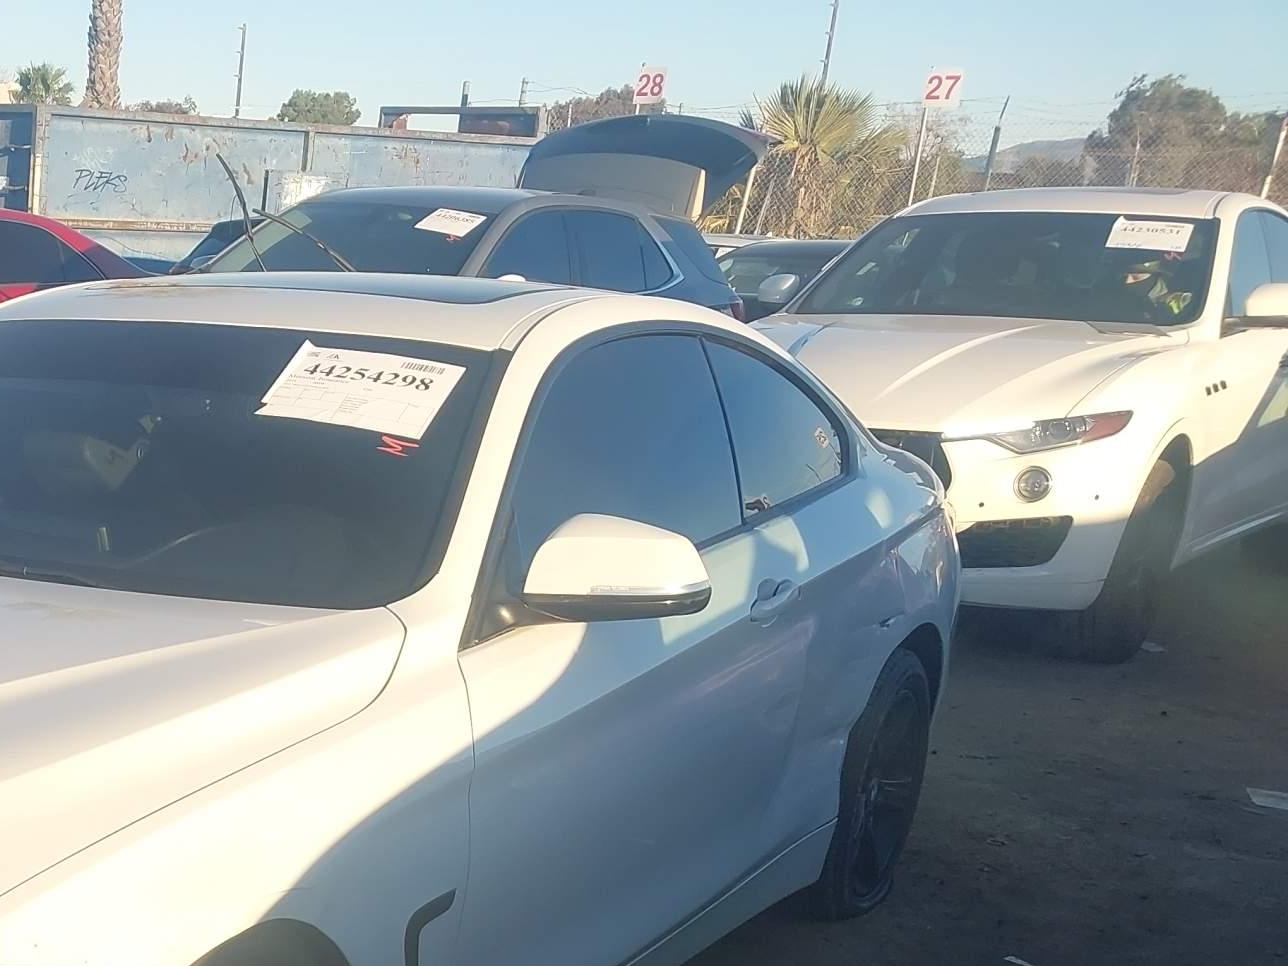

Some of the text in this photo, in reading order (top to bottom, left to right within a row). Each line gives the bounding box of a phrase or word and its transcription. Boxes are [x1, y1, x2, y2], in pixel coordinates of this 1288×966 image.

[636, 73, 664, 97] 28
[925, 75, 962, 100] 27
[303, 363, 434, 391] 44254298
